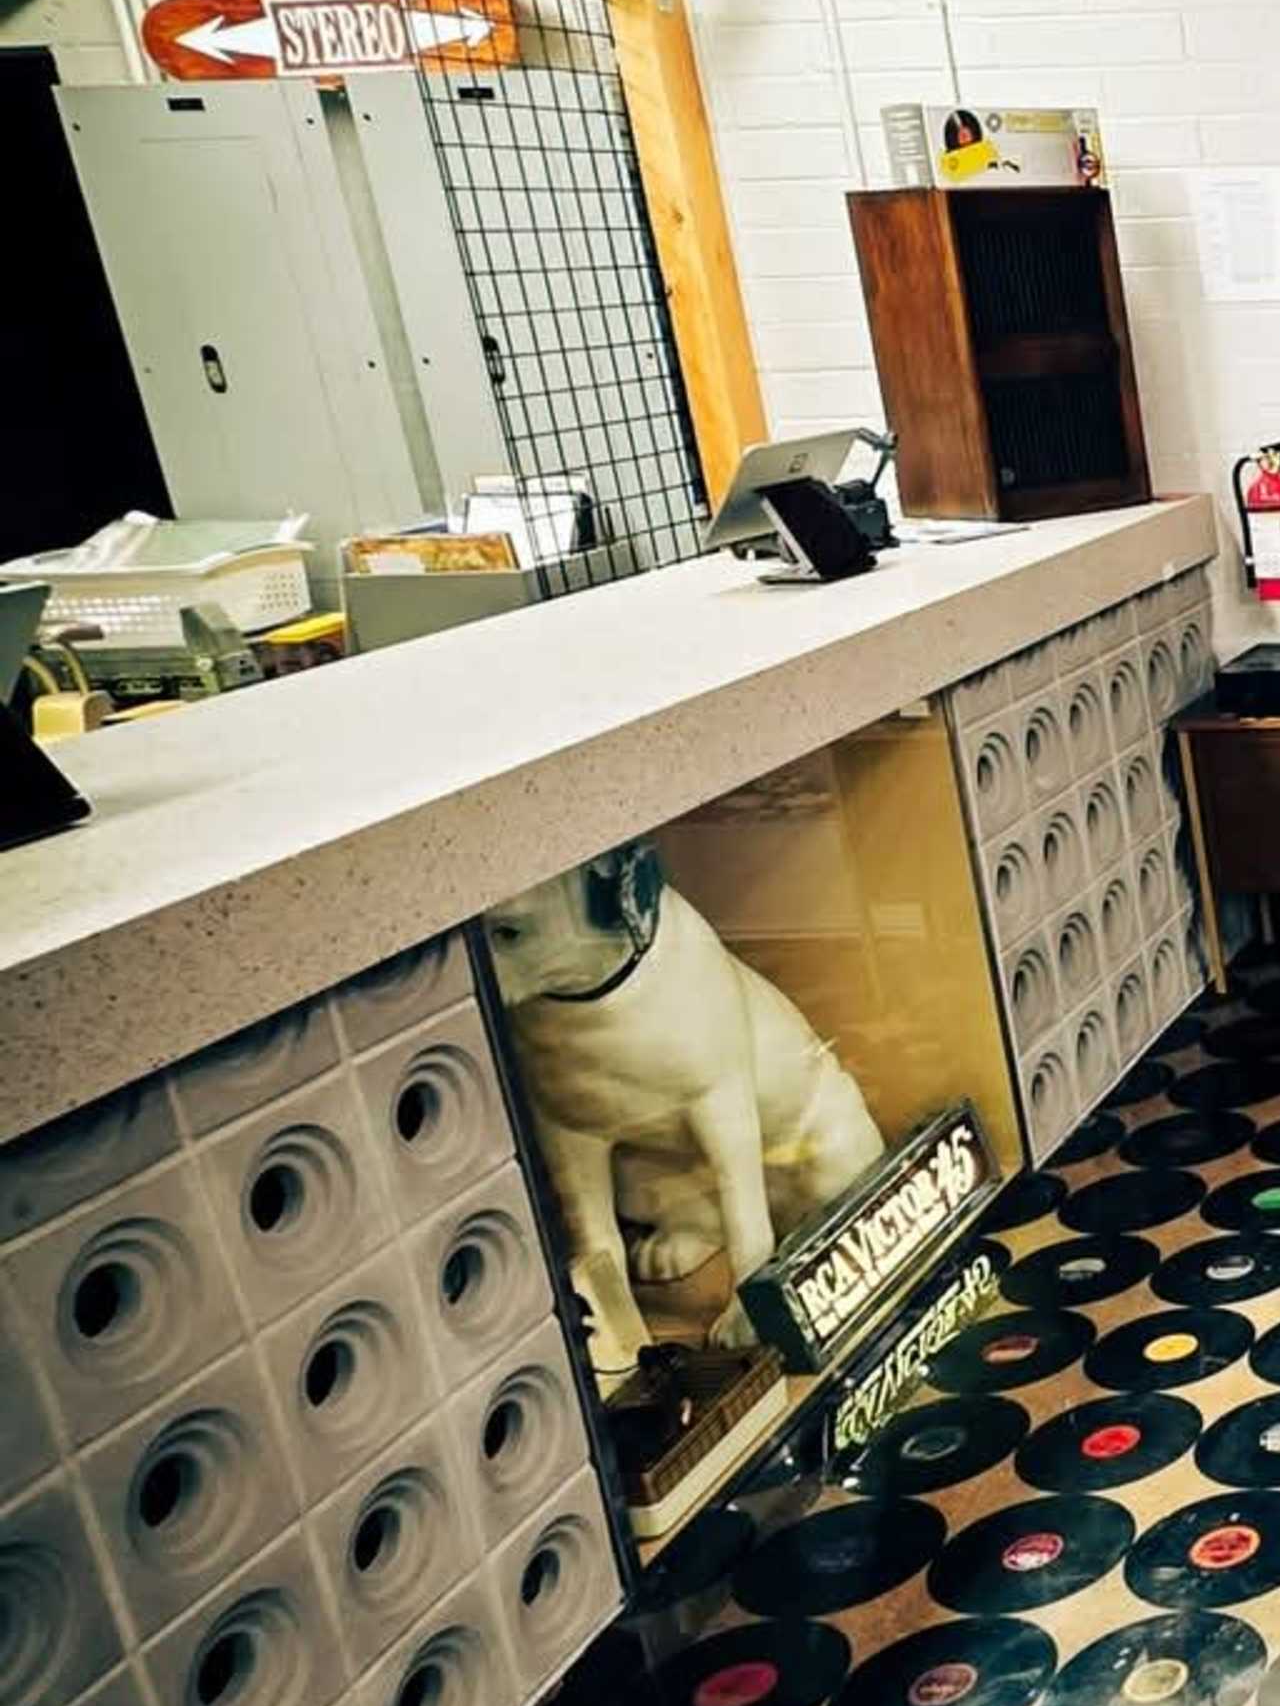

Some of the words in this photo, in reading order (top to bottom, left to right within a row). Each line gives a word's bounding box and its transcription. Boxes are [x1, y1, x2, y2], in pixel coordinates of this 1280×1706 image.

[279, 3, 405, 66] STEREO
[798, 1249, 851, 1325] RCA
[838, 1169, 943, 1277] VICTOR
[931, 1125, 976, 1211] 45
